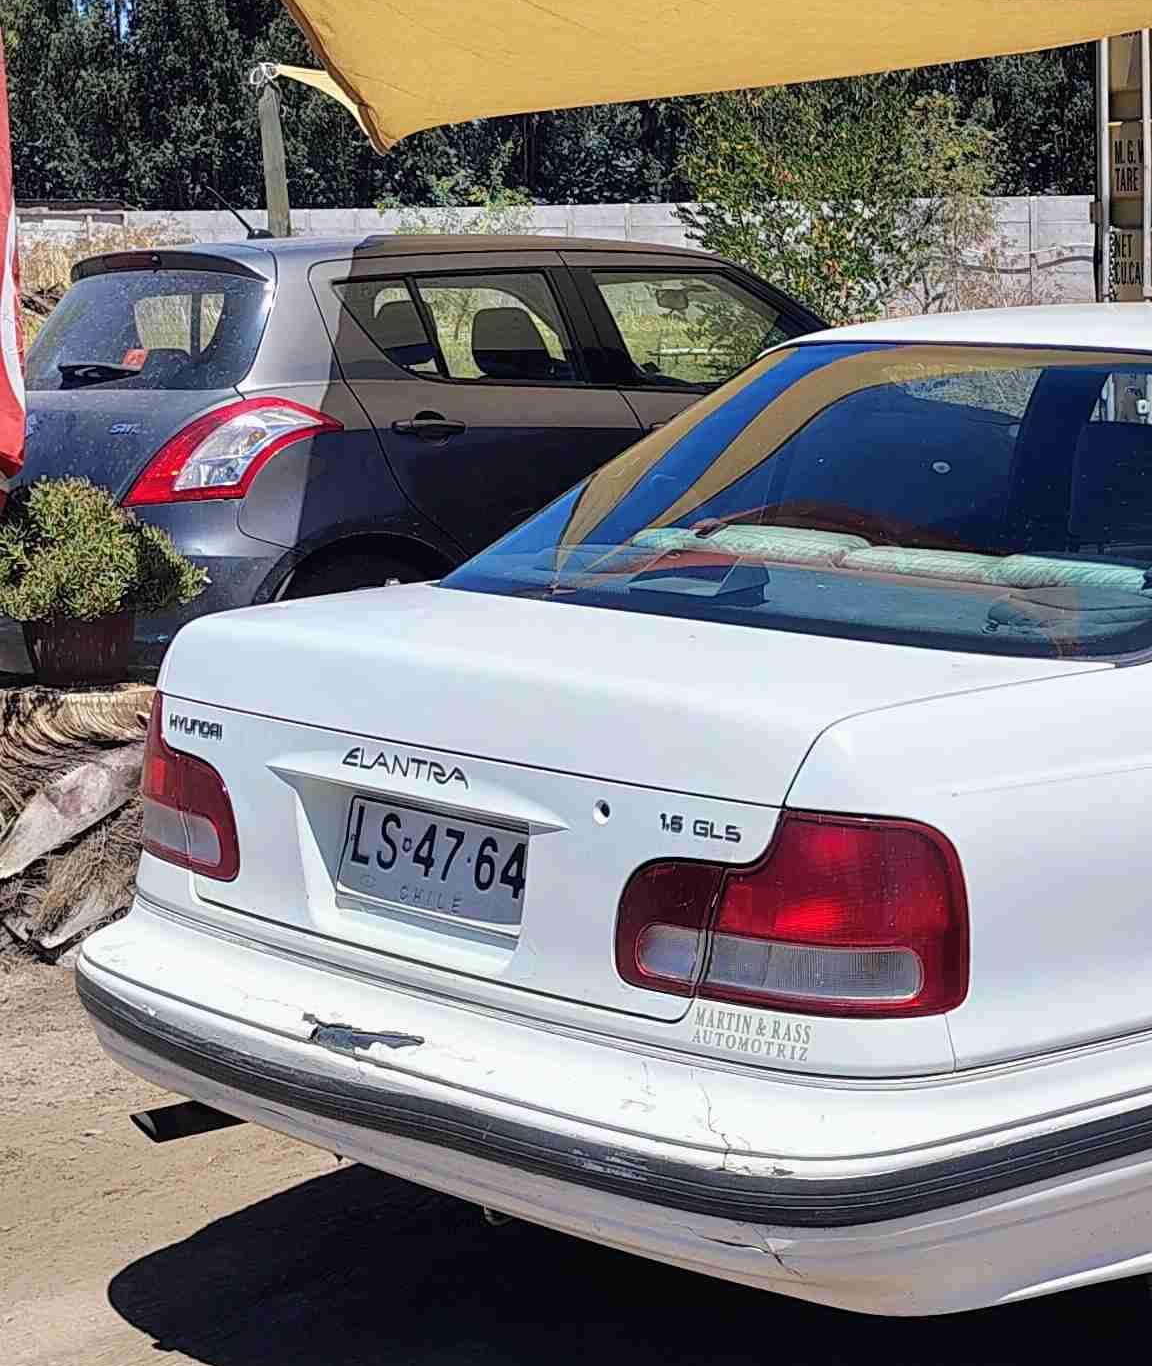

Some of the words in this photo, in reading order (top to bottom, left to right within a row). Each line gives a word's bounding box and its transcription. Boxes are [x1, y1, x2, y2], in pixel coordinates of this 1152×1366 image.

[1115, 167, 1139, 192] TARE
[169, 713, 223, 740] HYUNDAI
[342, 747, 469, 789] ELANTRA
[693, 819, 741, 843] GLS
[400, 885, 462, 914] CHILE
[694, 1007, 752, 1035] MARTIN
[756, 1017, 767, 1037] &
[772, 1020, 811, 1044] RASS
[692, 1029, 808, 1062] AUTOMOTRIZ
